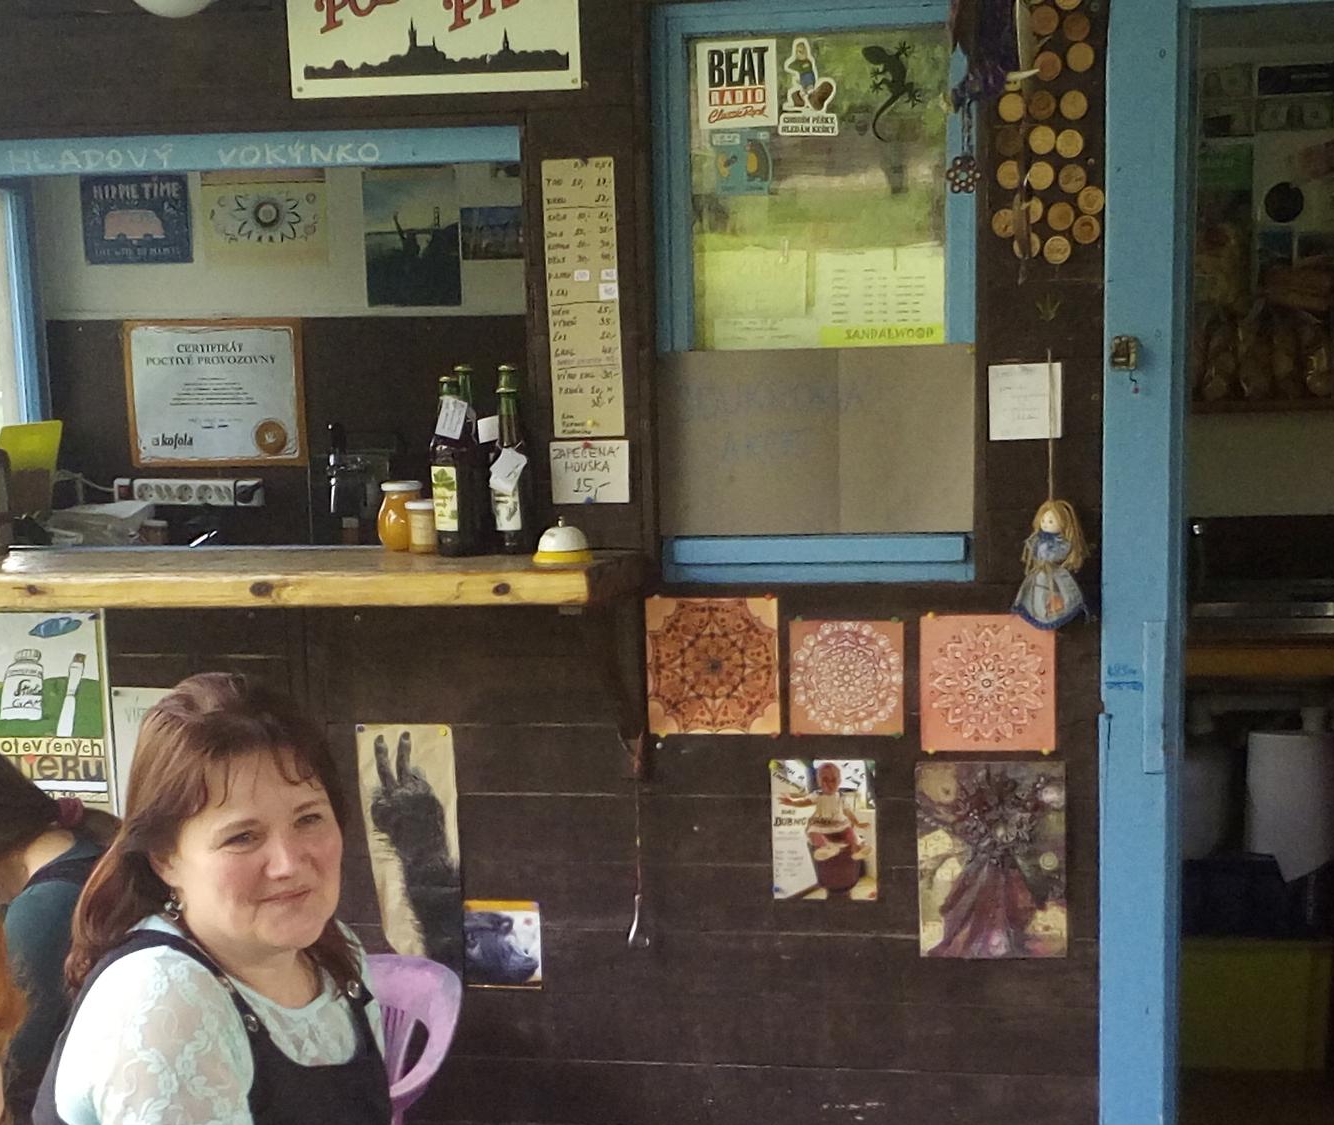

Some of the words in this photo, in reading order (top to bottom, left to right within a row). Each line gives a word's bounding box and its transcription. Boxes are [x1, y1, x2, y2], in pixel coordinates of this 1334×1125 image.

[708, 46, 769, 88] BEAT
[710, 88, 765, 106] RADIO
[9, 143, 174, 172] HLADOVÝ
[217, 137, 380, 165] VOKÝNKO
[845, 327, 935, 341] SANDALWOOD
[177, 341, 244, 354] CERTIFIKÁT
[146, 354, 194, 367] POCTIVÉ
[197, 354, 276, 366] PROVOZOVNY
[161, 432, 194, 450] kofola
[553, 446, 619, 460] ZAPEČENÁ
[565, 460, 610, 473] HOUSKA
